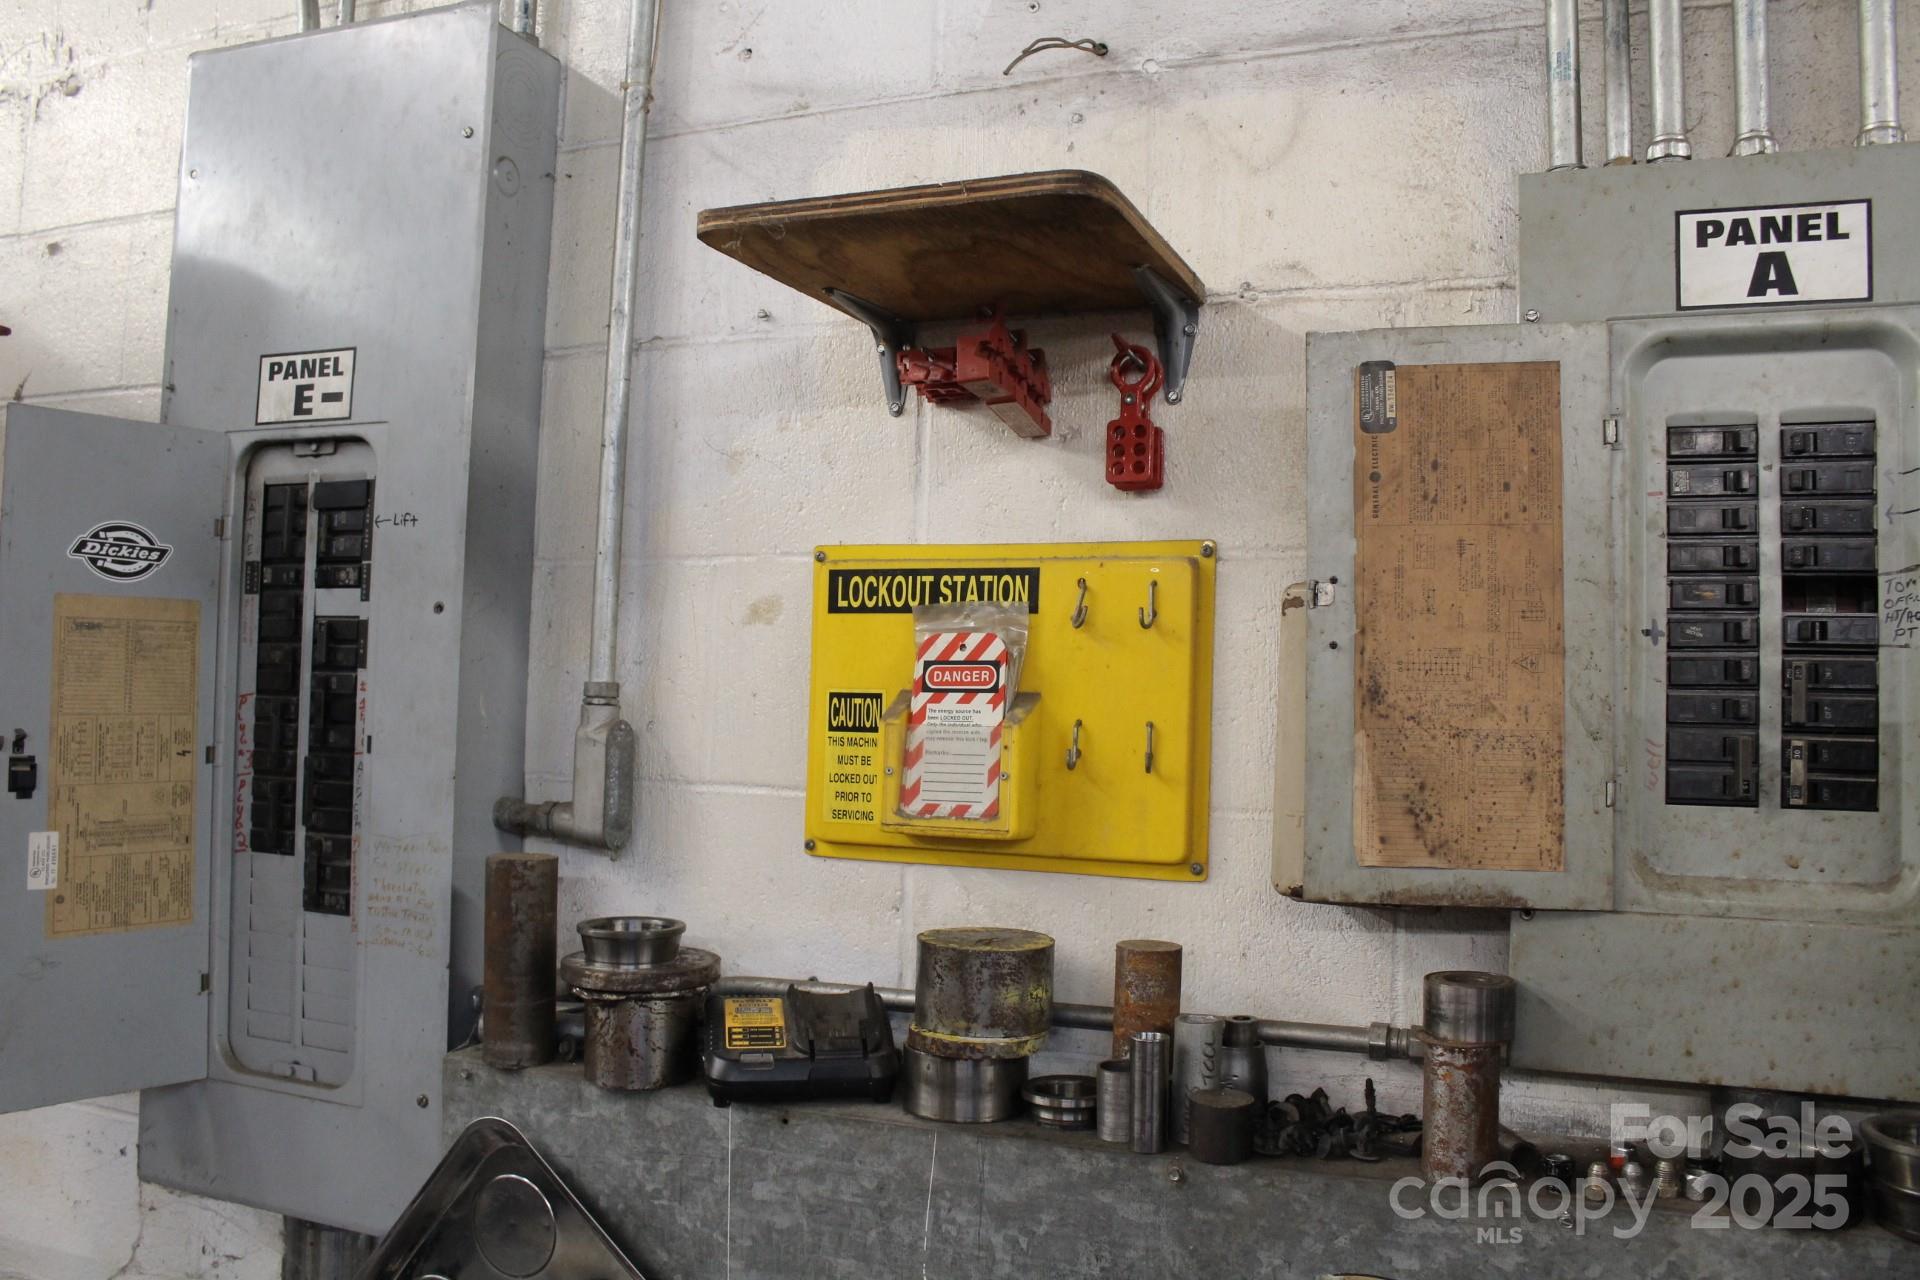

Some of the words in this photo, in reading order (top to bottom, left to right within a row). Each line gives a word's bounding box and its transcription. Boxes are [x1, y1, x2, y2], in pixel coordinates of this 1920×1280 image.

[1695, 212, 1850, 248] PANEL
[1746, 251, 1799, 297] A
[268, 356, 344, 381] PANEL
[393, 512, 419, 528] Lift
[81, 541, 161, 561] Dickies
[837, 575, 935, 608] LOCKOUT
[939, 574, 1030, 606] STATION
[933, 670, 990, 682] DANGER
[830, 697, 881, 728] CAUTION
[827, 736, 845, 747] THIS
[837, 755, 859, 766] MUST
[860, 755, 872, 766] BE
[829, 773, 861, 784] LOCKED
[835, 791, 859, 802] PRIOR
[861, 793, 872, 803] TO
[831, 809, 874, 821] SERVICING
